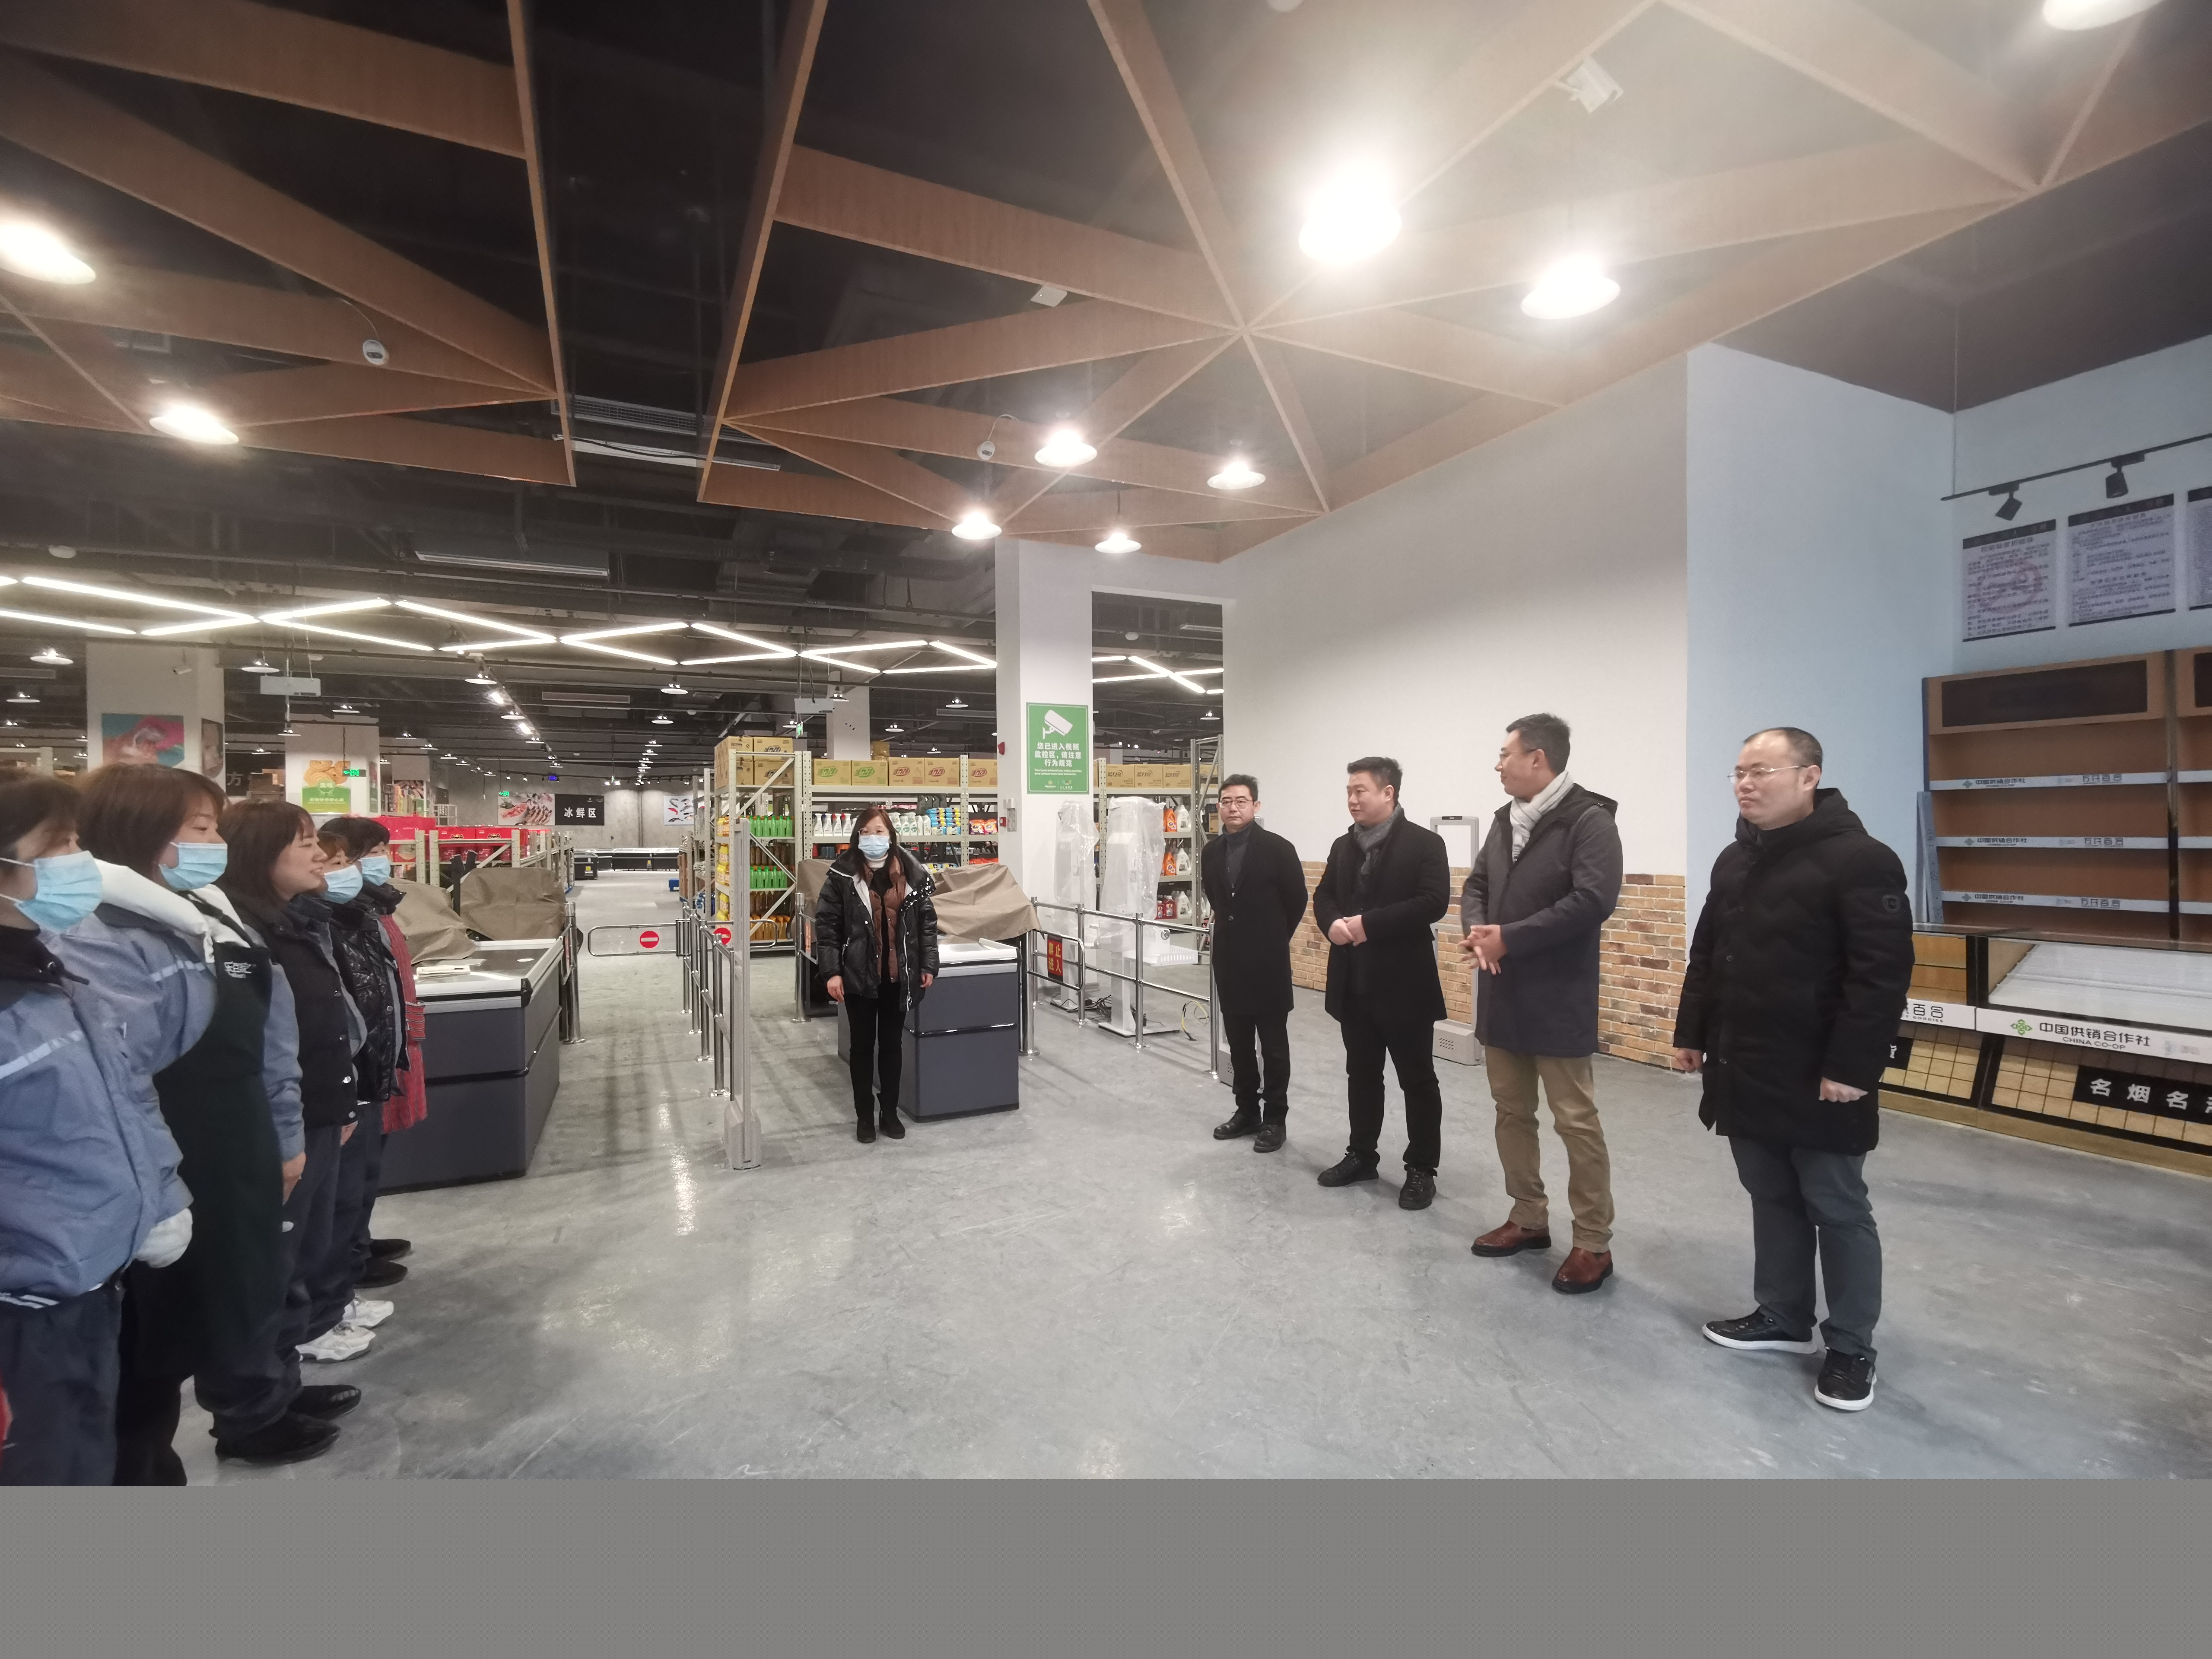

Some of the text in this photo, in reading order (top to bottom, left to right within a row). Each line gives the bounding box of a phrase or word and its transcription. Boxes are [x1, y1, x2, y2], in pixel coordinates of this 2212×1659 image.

[1037, 742, 1079, 750] 您已进入视频
[1035, 750, 1081, 759] 监控区，请注意
[226, 771, 251, 786] 方
[564, 807, 597, 818] 冰鲜区
[1049, 942, 1061, 958] 禁止
[1049, 957, 1062, 973] 进入
[1906, 1003, 1943, 1018] 百合
[2039, 1022, 2151, 1047] 中国供销合作社
[2063, 1036, 2126, 1050] CHINA CO-OP
